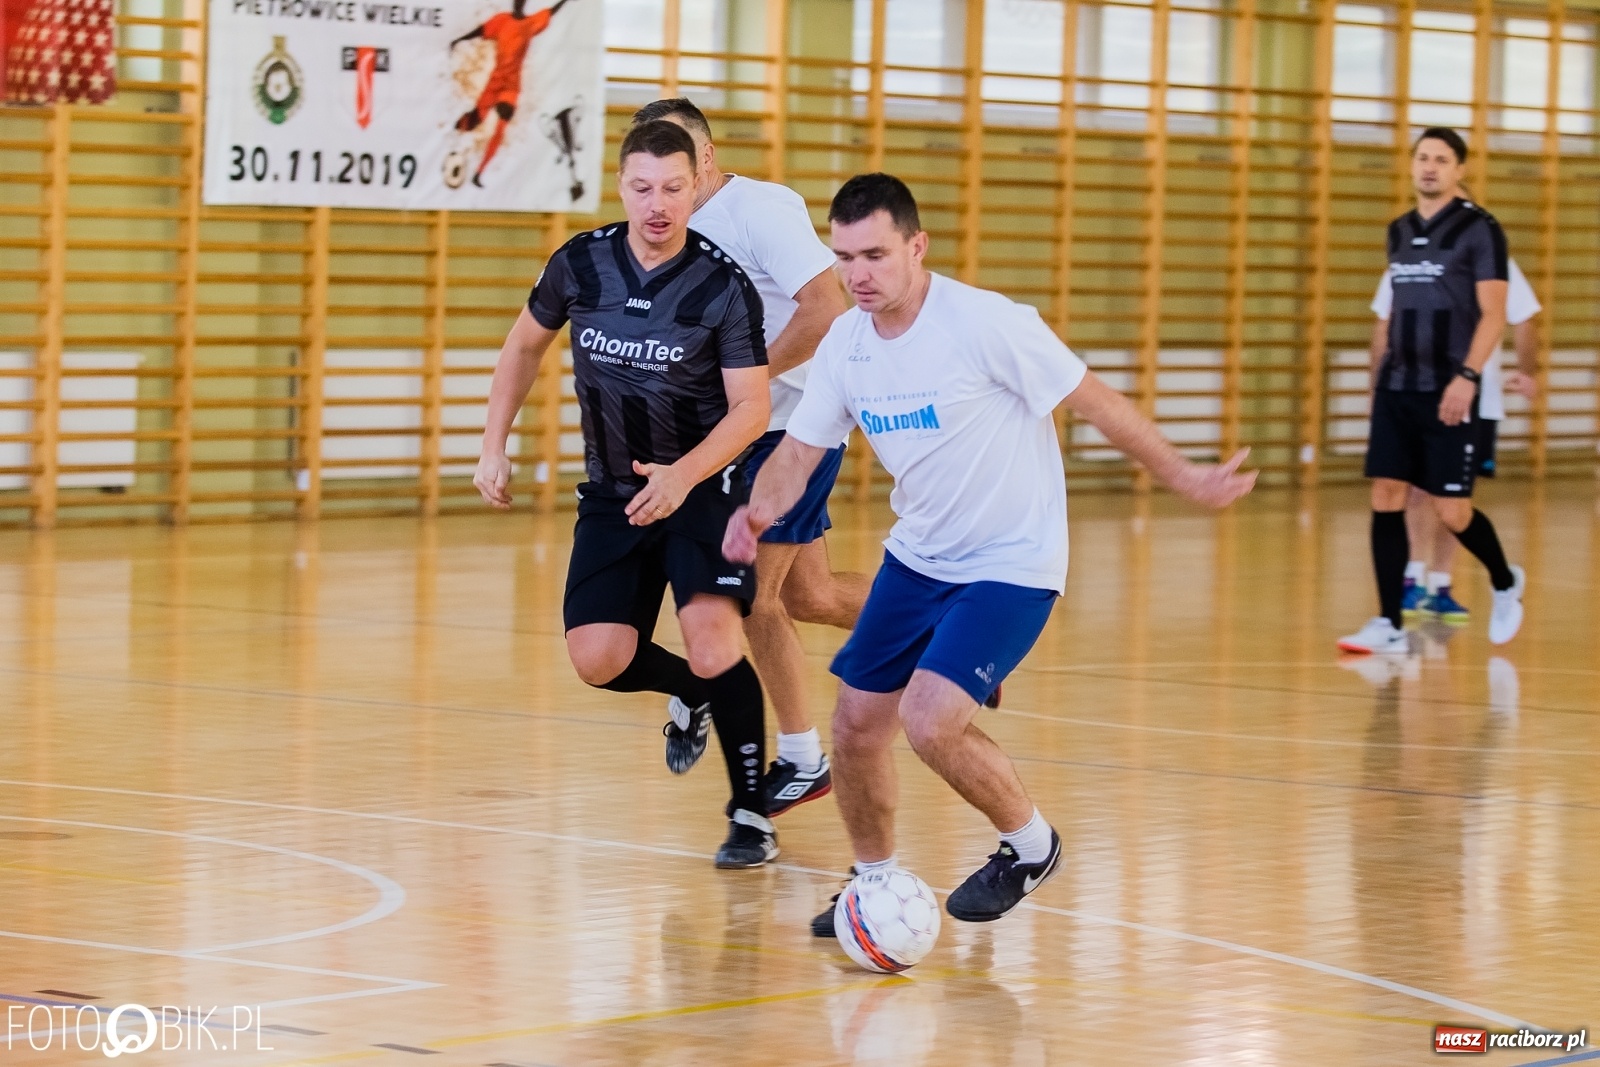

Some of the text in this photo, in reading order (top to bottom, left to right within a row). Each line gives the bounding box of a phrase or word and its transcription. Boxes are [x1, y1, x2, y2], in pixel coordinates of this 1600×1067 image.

[363, 3, 444, 27] WIELKIE
[229, 145, 417, 188] 30.11.2019
[626, 297, 652, 310] JAKO
[579, 327, 684, 362] ChomTec
[589, 352, 669, 372] WASSER ENERGIE
[861, 403, 940, 435] SOLIDUM
